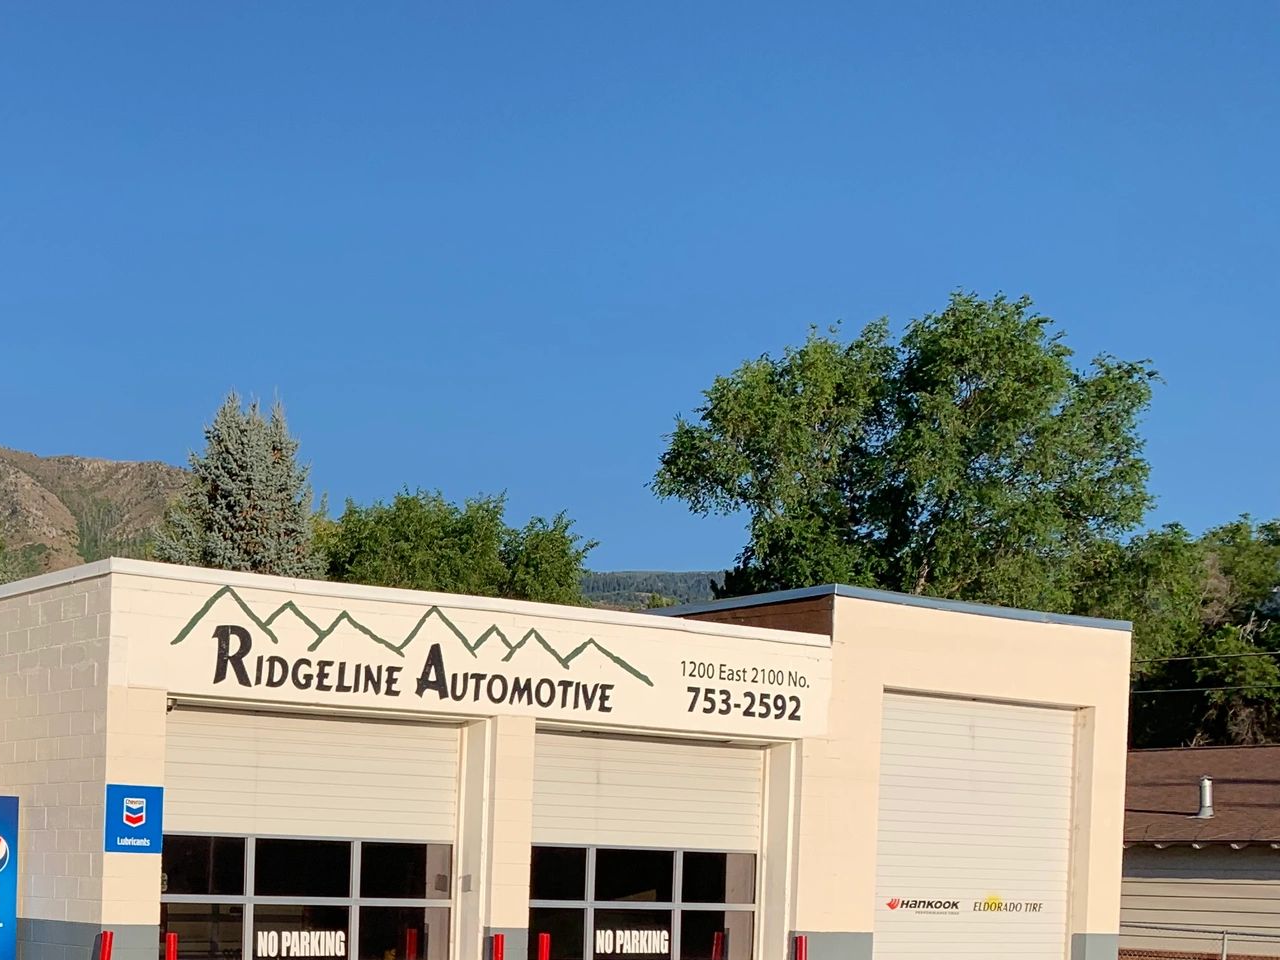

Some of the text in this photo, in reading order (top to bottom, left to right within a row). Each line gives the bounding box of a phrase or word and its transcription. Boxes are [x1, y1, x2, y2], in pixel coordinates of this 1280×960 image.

[211, 625, 615, 713] RIDGELINE AUTOMOTIVE
[680, 660, 810, 689] 1200 East 2100 No.
[686, 686, 801, 722] 753-2592
[117, 836, 150, 846] Lubricants
[973, 901, 1023, 912] ELDORADO
[257, 930, 346, 957] NO PARKING
[595, 929, 669, 954] NO PARKING
